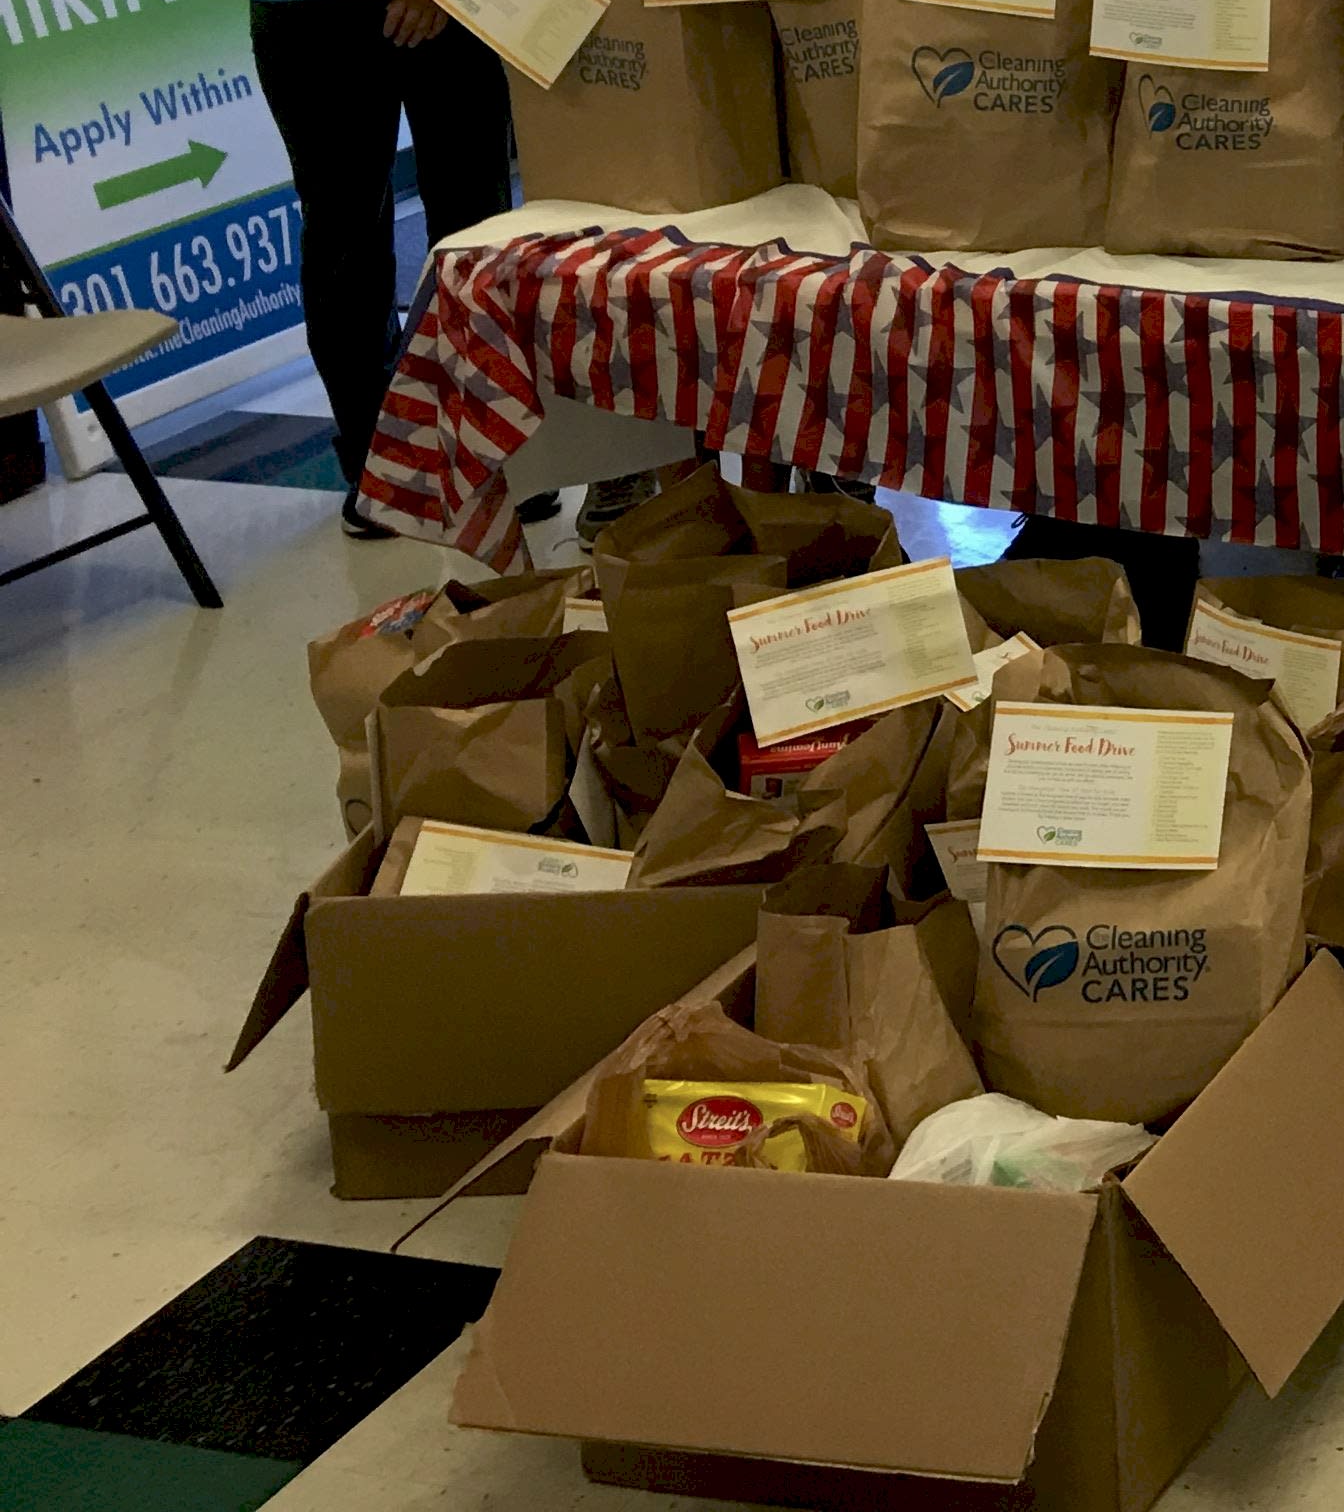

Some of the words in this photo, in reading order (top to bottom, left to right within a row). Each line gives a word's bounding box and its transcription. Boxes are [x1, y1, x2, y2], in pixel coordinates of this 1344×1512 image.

[781, 20, 857, 46] Cleaning
[784, 39, 860, 65] Authority
[978, 51, 1065, 77] Cleaning
[791, 57, 854, 83] CARES
[975, 71, 1067, 99] Authority
[34, 101, 132, 164] Apply
[139, 68, 252, 125] Within
[974, 92, 1054, 114] CARES
[1182, 94, 1271, 116] Cleaning
[1176, 113, 1273, 137] Authority
[1176, 134, 1261, 150] CARES
[61, 200, 304, 317] 301663.937
[751, 627, 801, 653] Summer
[803, 612, 832, 634] Food
[836, 607, 870, 626] Drive
[1004, 732, 1060, 756] Summer
[1064, 736, 1093, 753] Food
[1098, 738, 1136, 756] Drive
[1086, 923, 1207, 954] Cleaning
[1081, 951, 1208, 982] Authority
[1081, 976, 1189, 1004] CARES
[681, 1103, 753, 1133] Streit's
